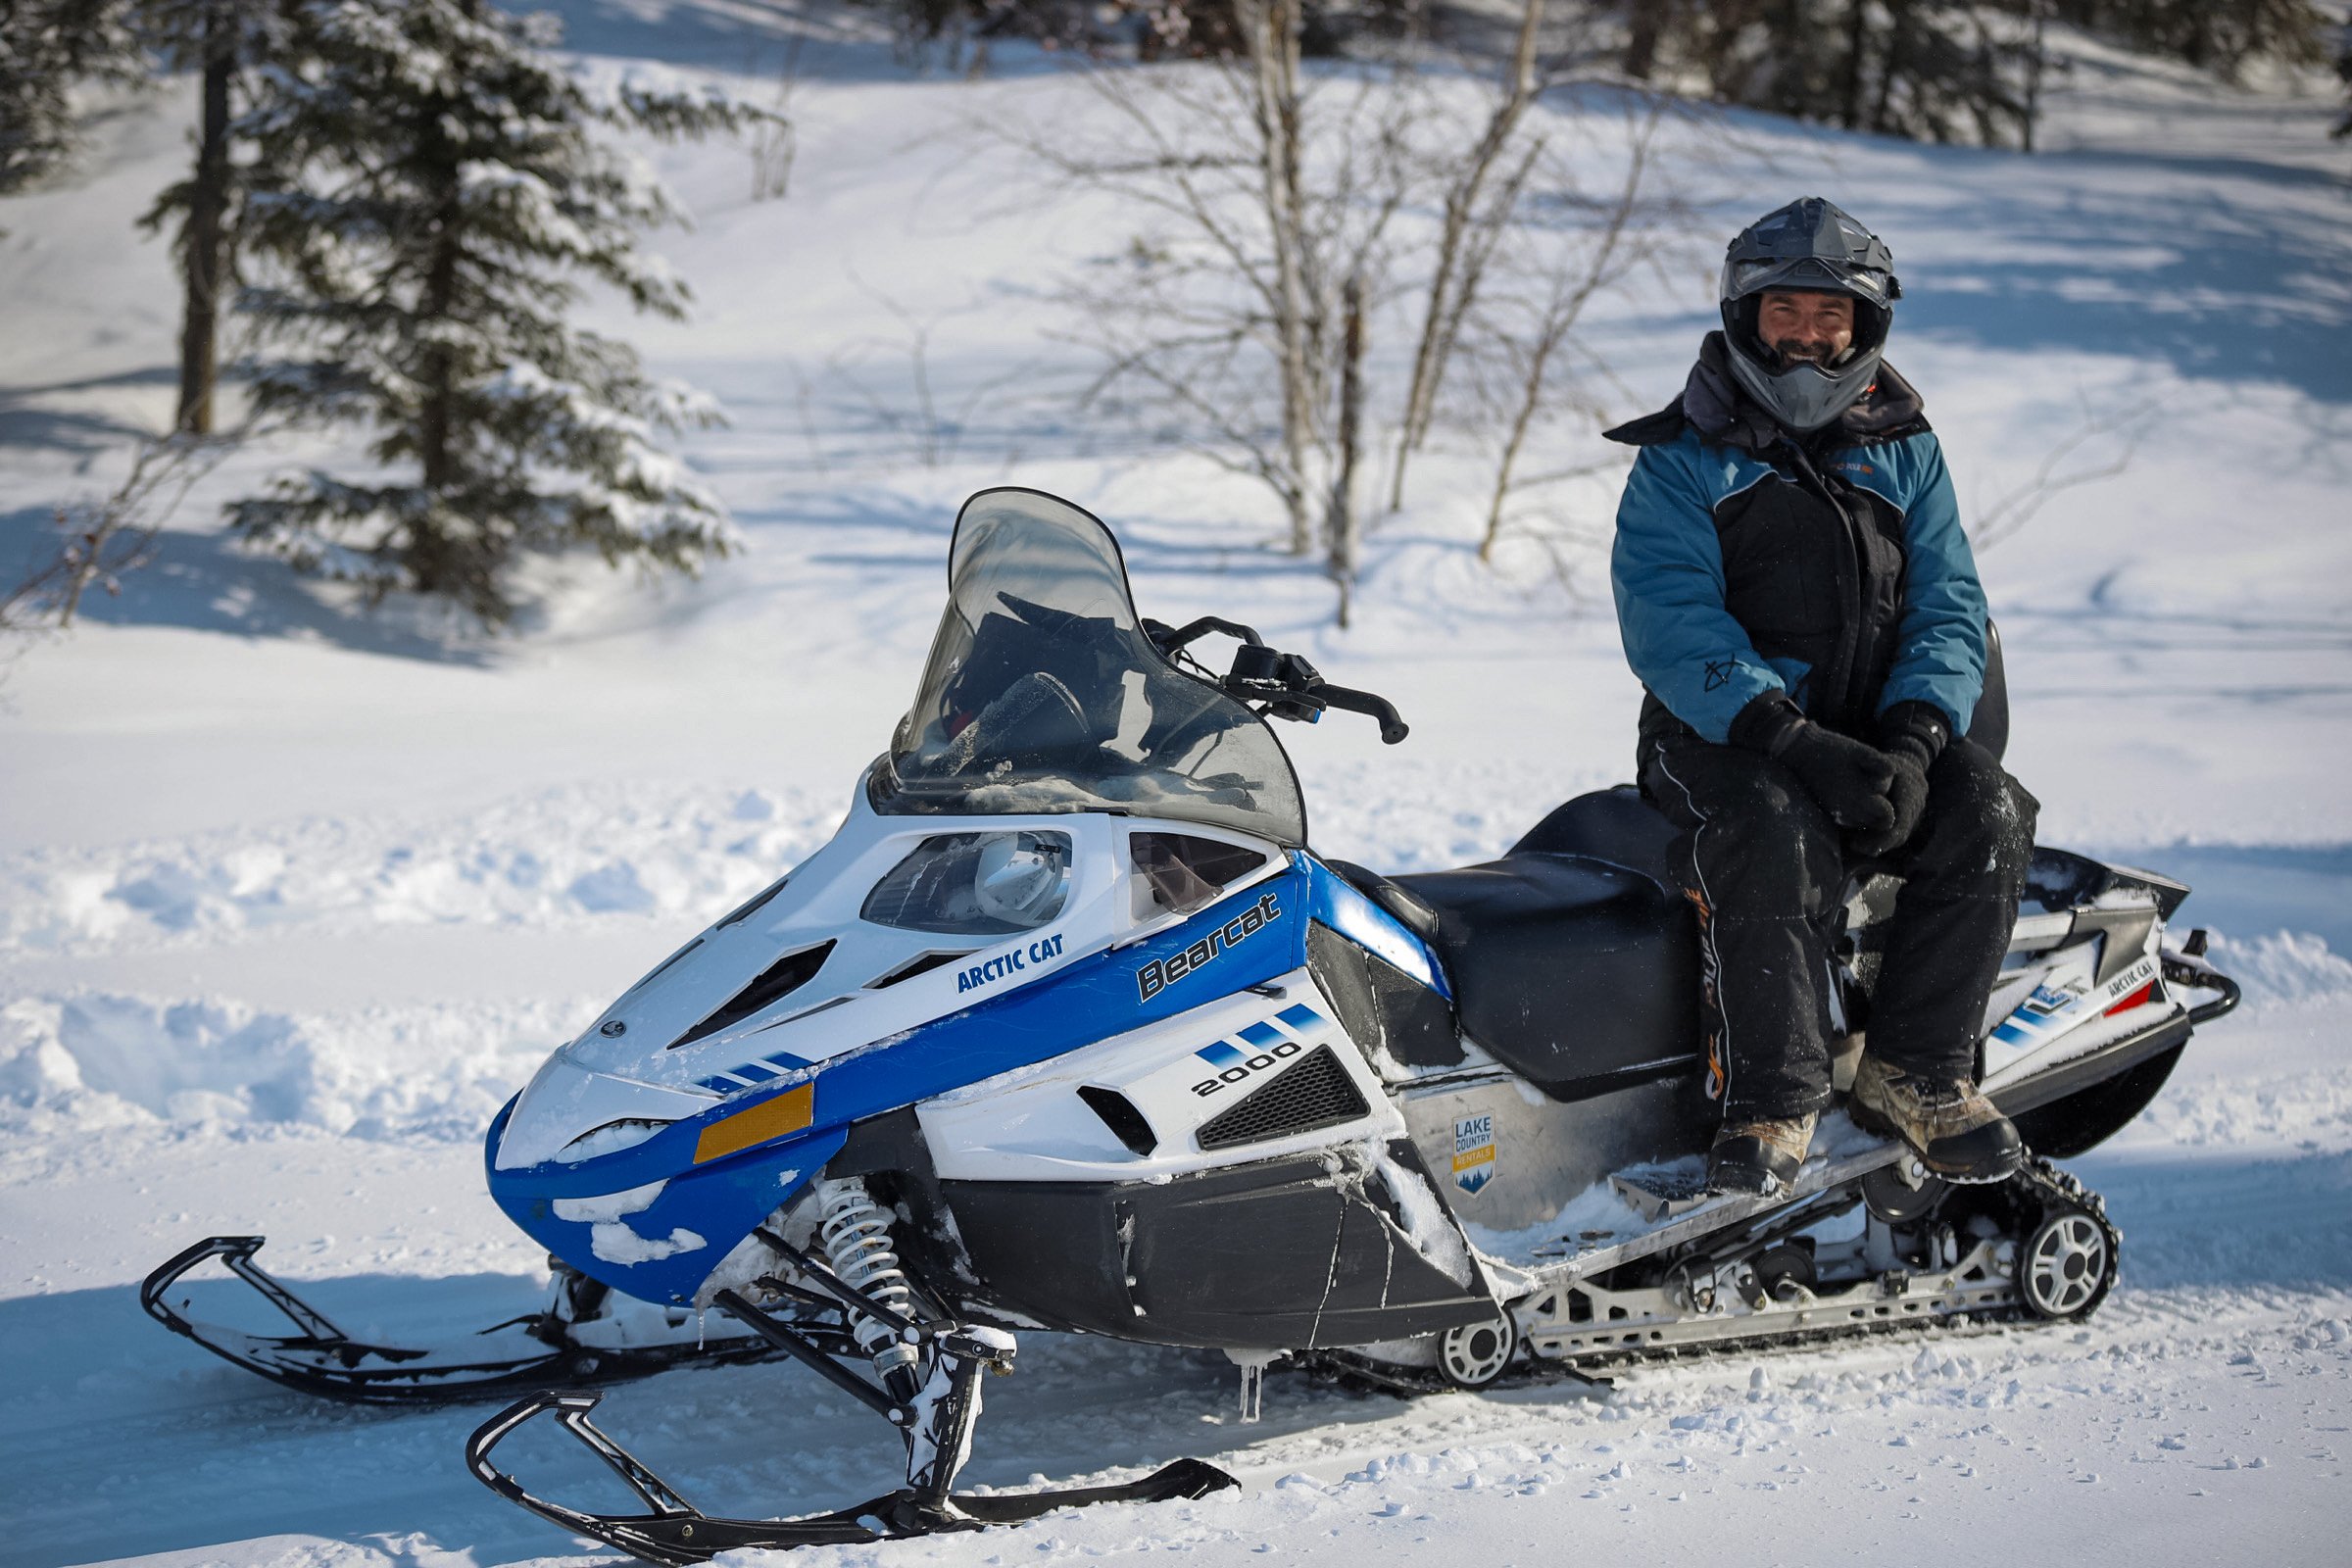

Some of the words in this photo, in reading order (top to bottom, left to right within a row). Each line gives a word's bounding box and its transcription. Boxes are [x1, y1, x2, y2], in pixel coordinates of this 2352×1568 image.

[1137, 893, 1281, 1003] Bearcat
[957, 949, 1025, 994] ARCTIC
[1028, 933, 1063, 963] CAT
[2107, 971, 2138, 998] ARCTIC
[1191, 1042, 1301, 1097] 2000
[1455, 1116, 1491, 1138] LAKE
[1455, 1133, 1491, 1152] COUNTRY
[1456, 1148, 1491, 1166] RENTALS
